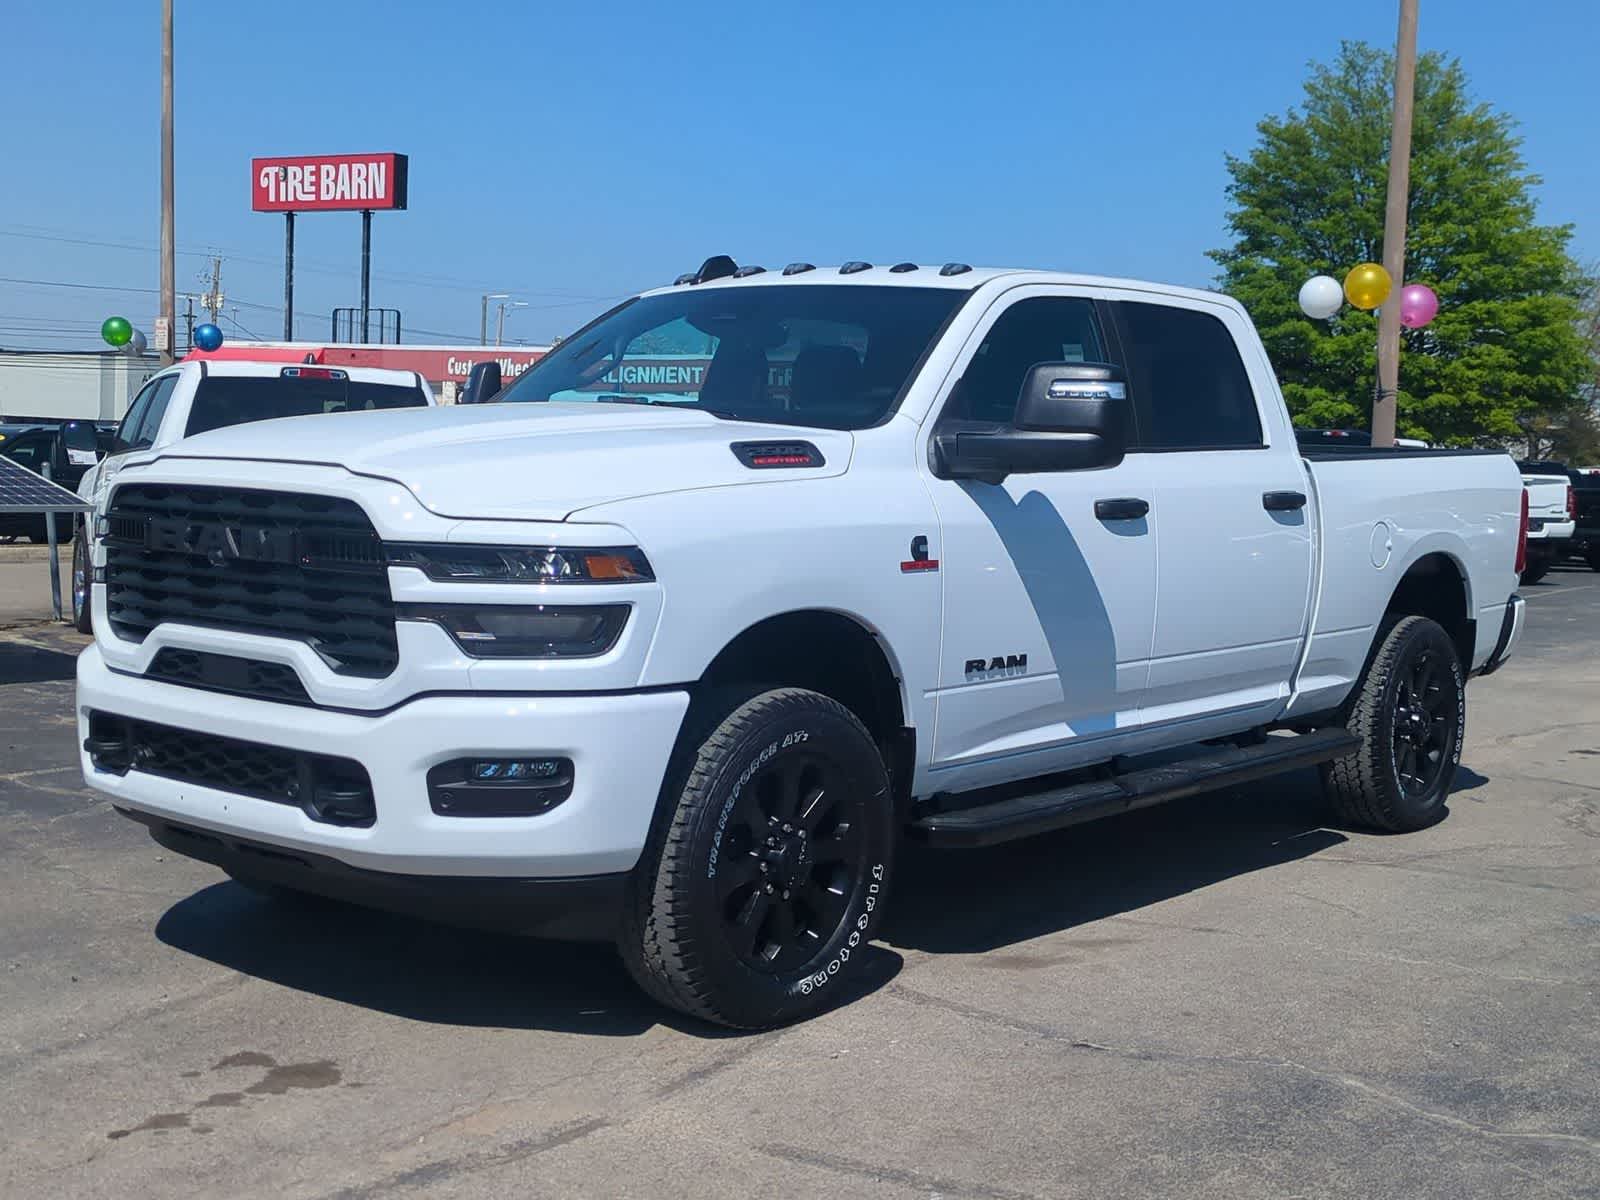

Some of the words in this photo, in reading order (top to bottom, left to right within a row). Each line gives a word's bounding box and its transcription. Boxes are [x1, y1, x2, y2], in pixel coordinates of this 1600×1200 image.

[320, 162, 386, 201] BARN
[447, 357, 478, 376] Cust
[964, 654, 1028, 674] RAM
